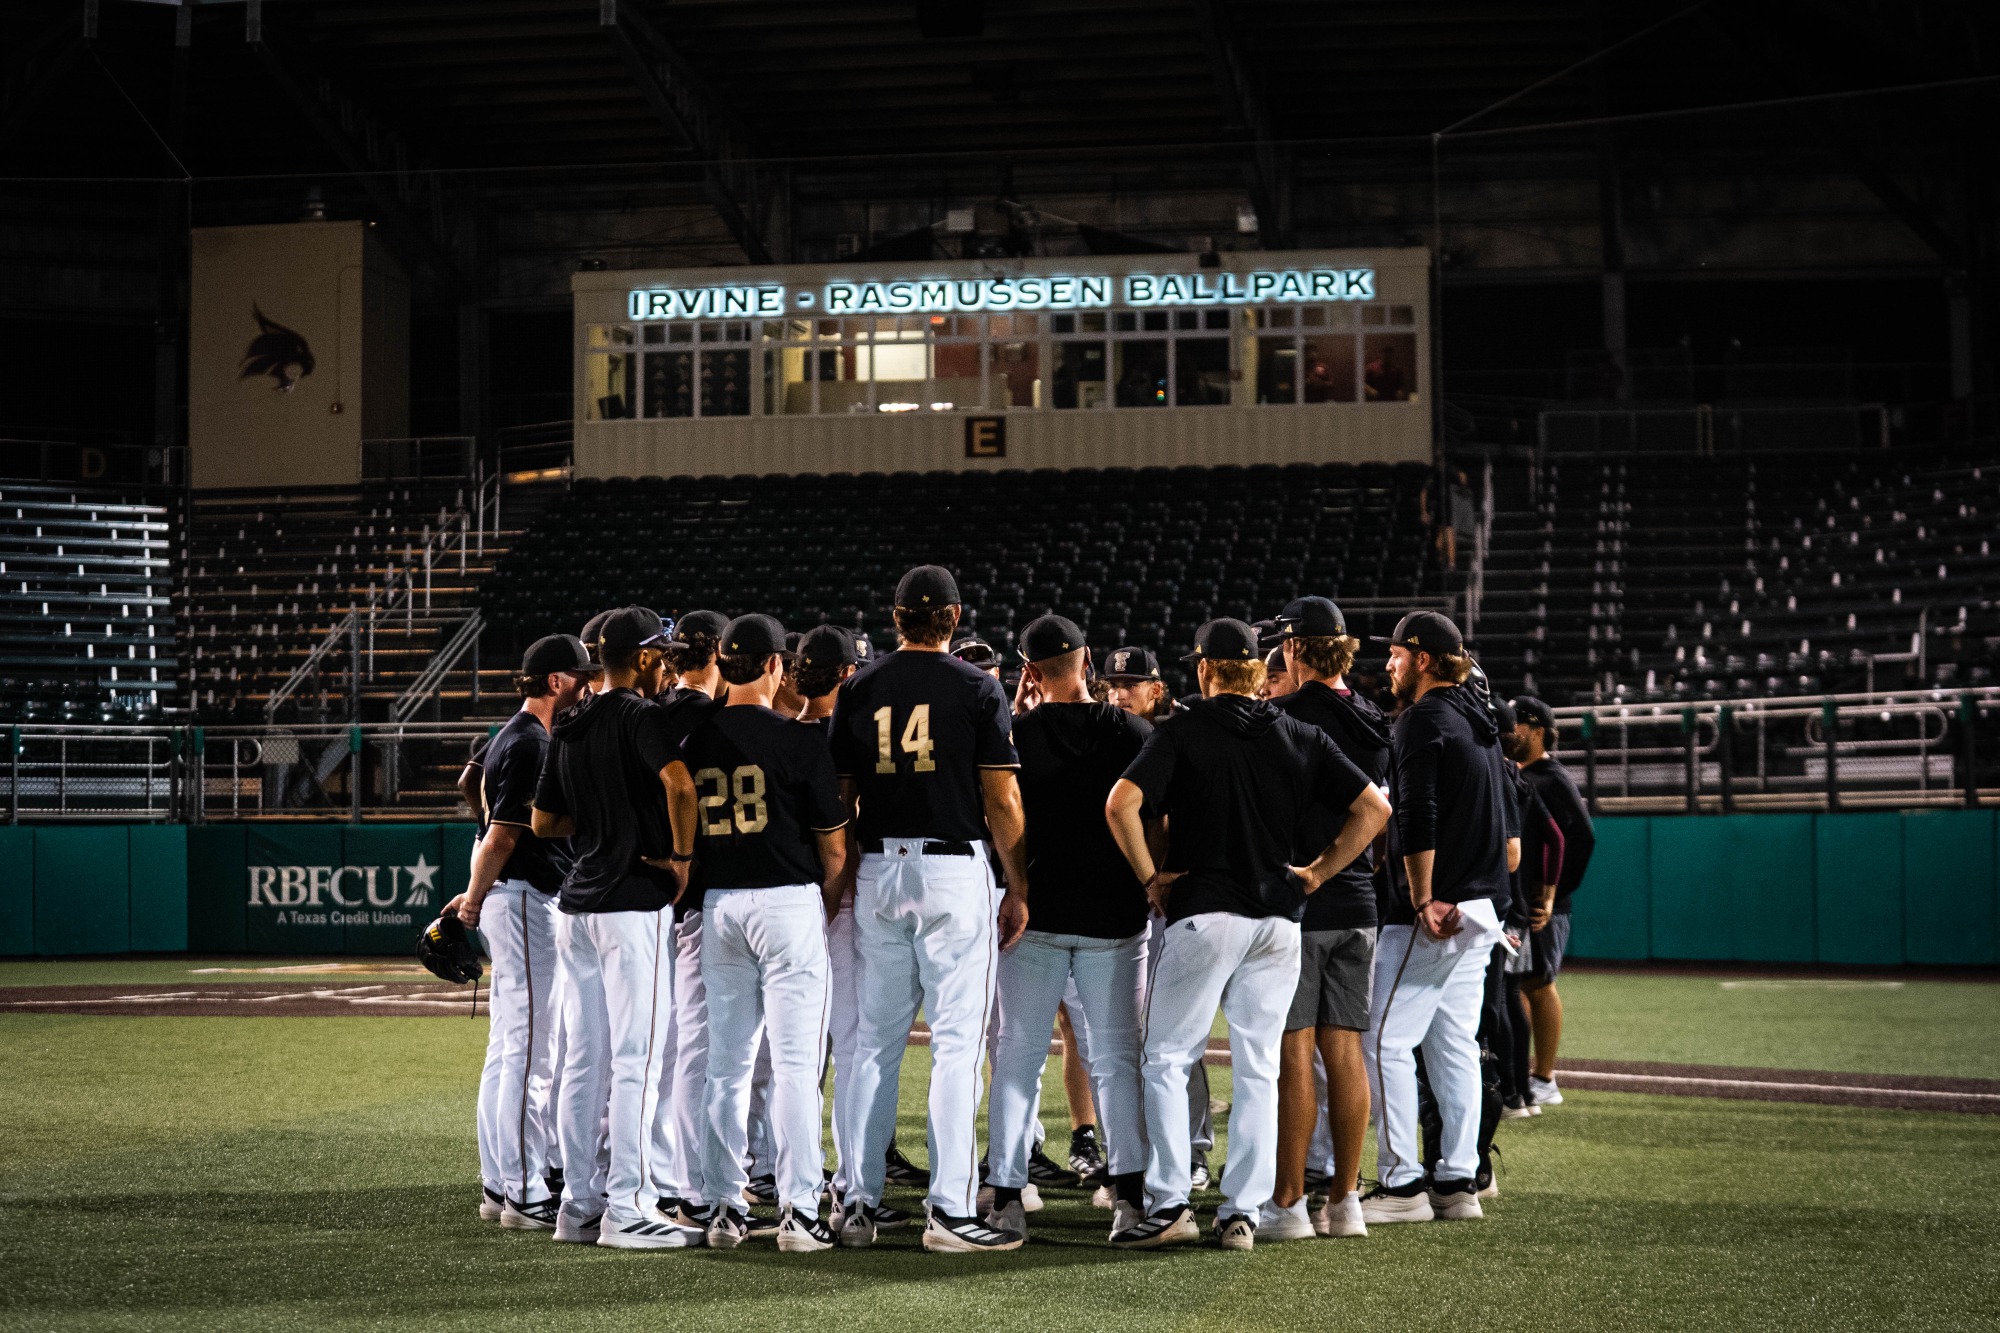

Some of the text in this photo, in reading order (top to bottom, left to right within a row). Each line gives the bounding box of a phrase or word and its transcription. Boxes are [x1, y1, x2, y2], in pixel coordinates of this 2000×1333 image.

[631, 284, 782, 318] IRVINE
[828, 275, 1108, 313] RASMUSSEN
[1128, 268, 1374, 302] BALLPARK
[973, 420, 998, 454] E
[81, 447, 106, 479] D
[873, 704, 936, 775] 14
[694, 764, 768, 836] 28
[247, 865, 402, 907] RBFCU
[276, 911, 412, 925] A Texas Credit Union
